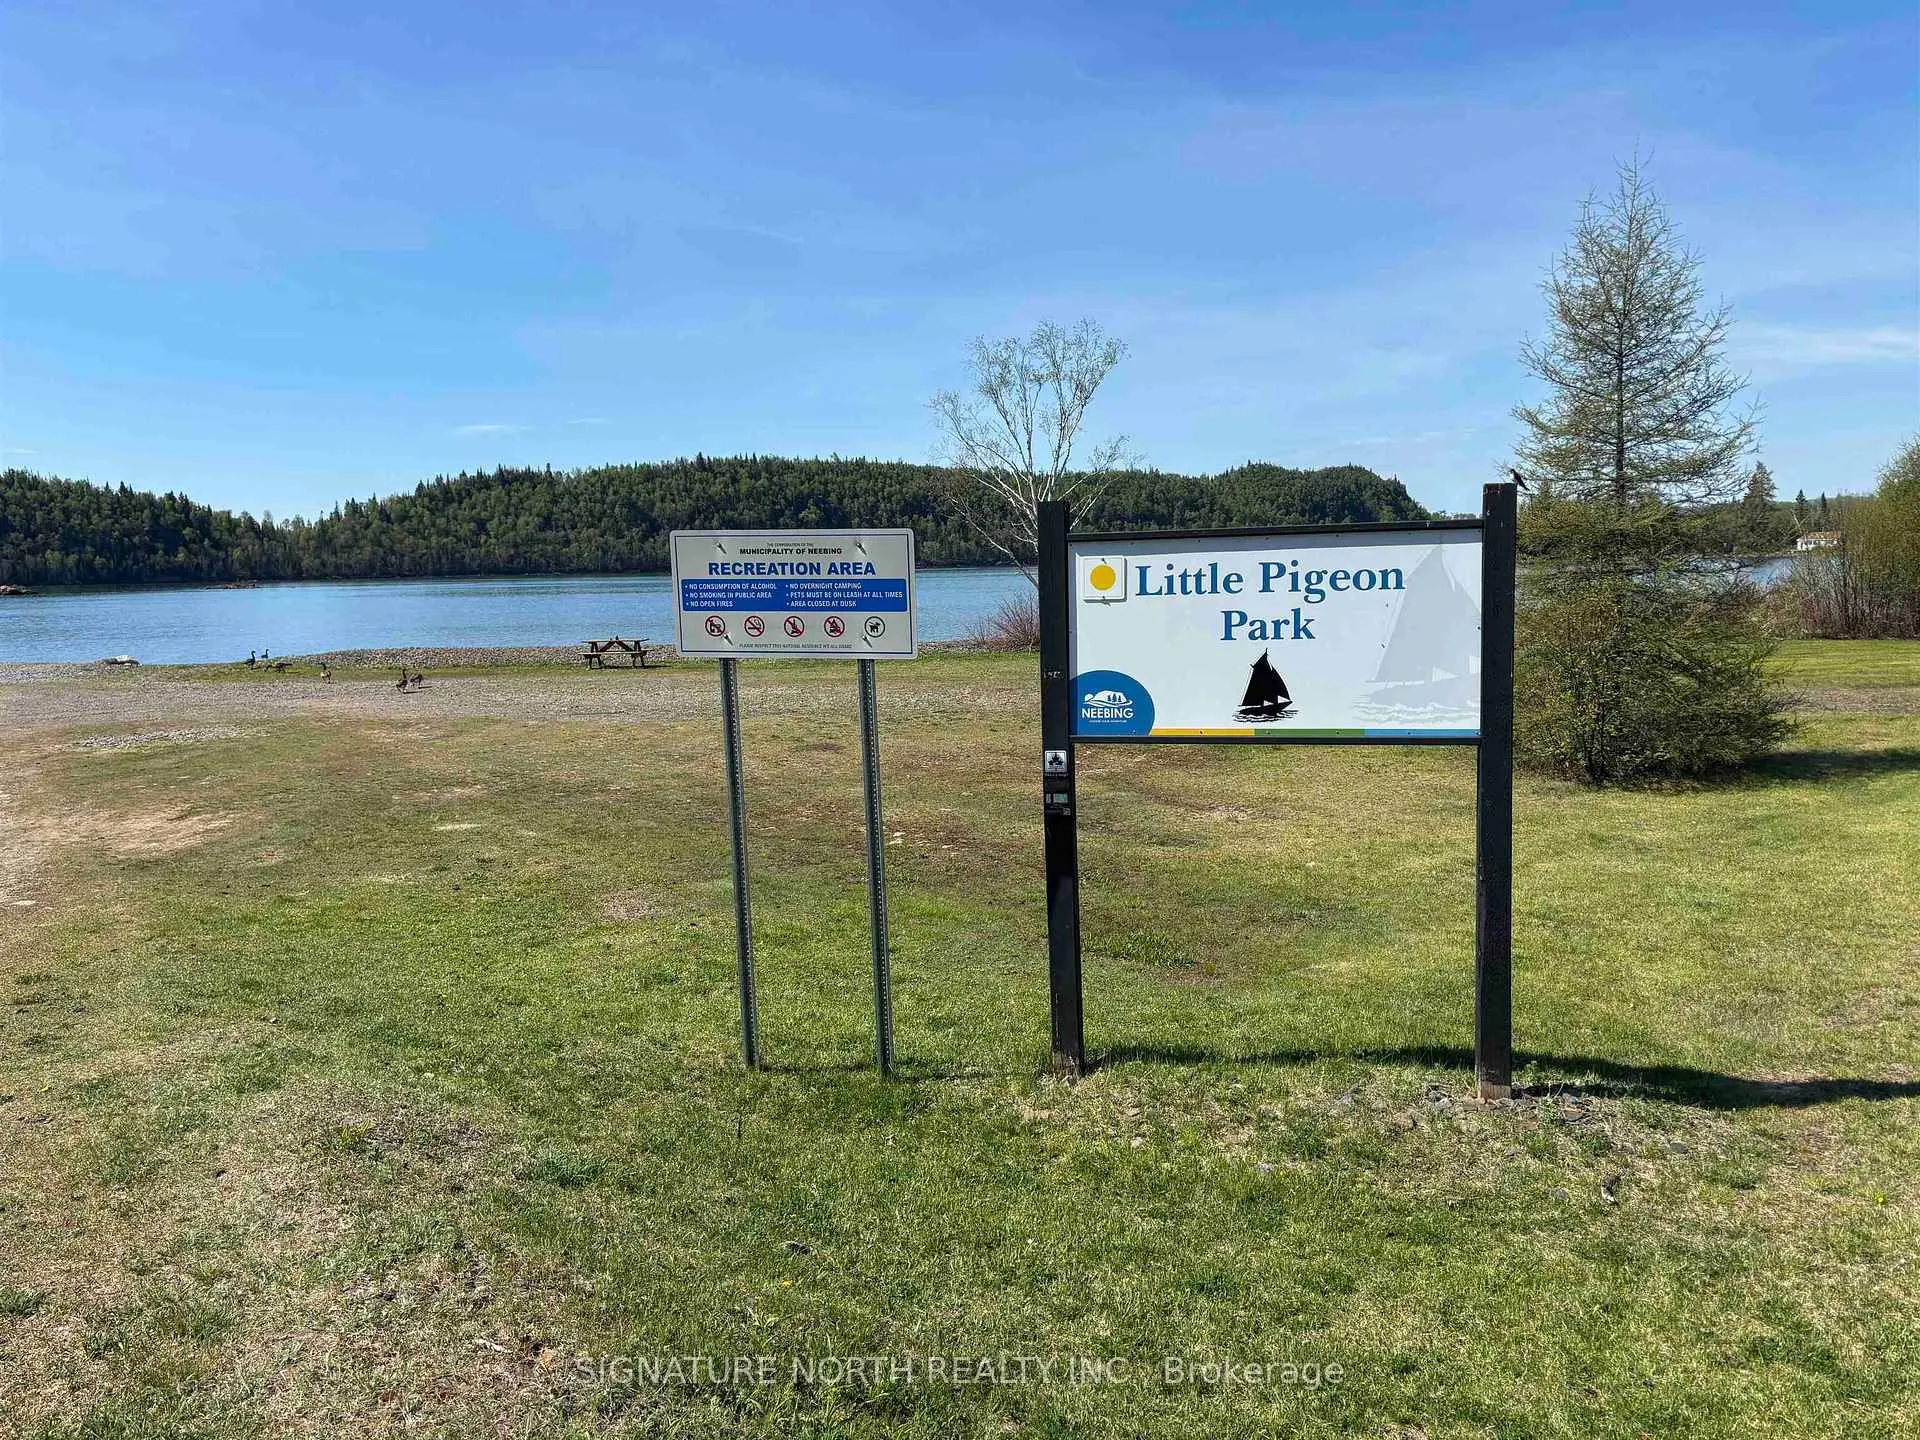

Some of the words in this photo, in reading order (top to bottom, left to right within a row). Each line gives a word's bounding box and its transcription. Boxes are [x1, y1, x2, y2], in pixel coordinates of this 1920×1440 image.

[708, 562, 821, 576] RECREATION
[827, 562, 876, 576] AREA
[1135, 562, 1244, 596] Little
[1258, 559, 1406, 604] Pigeon
[1220, 607, 1316, 641] Park
[1082, 708, 1134, 718] NEEBING
